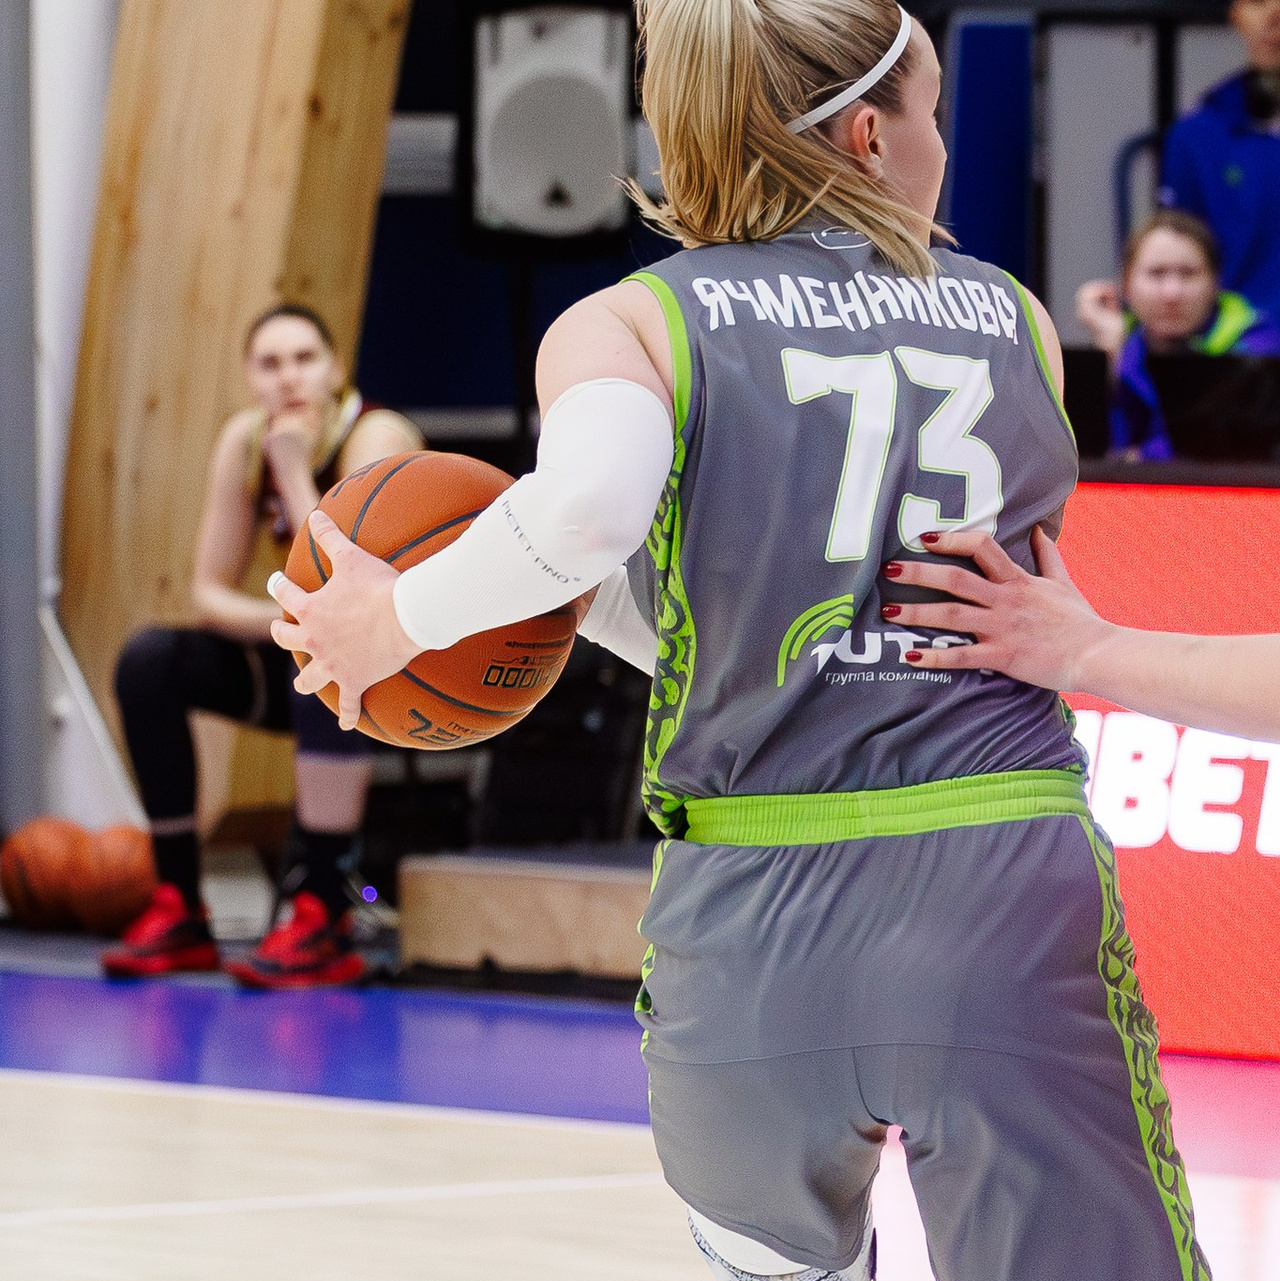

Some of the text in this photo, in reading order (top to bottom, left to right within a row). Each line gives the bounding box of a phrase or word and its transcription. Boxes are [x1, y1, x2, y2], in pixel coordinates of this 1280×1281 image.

[692, 271, 1018, 345] ЯЧМЕННИКОВА
[781, 346, 1003, 562] 73
[825, 671, 952, 686] группа компаний
